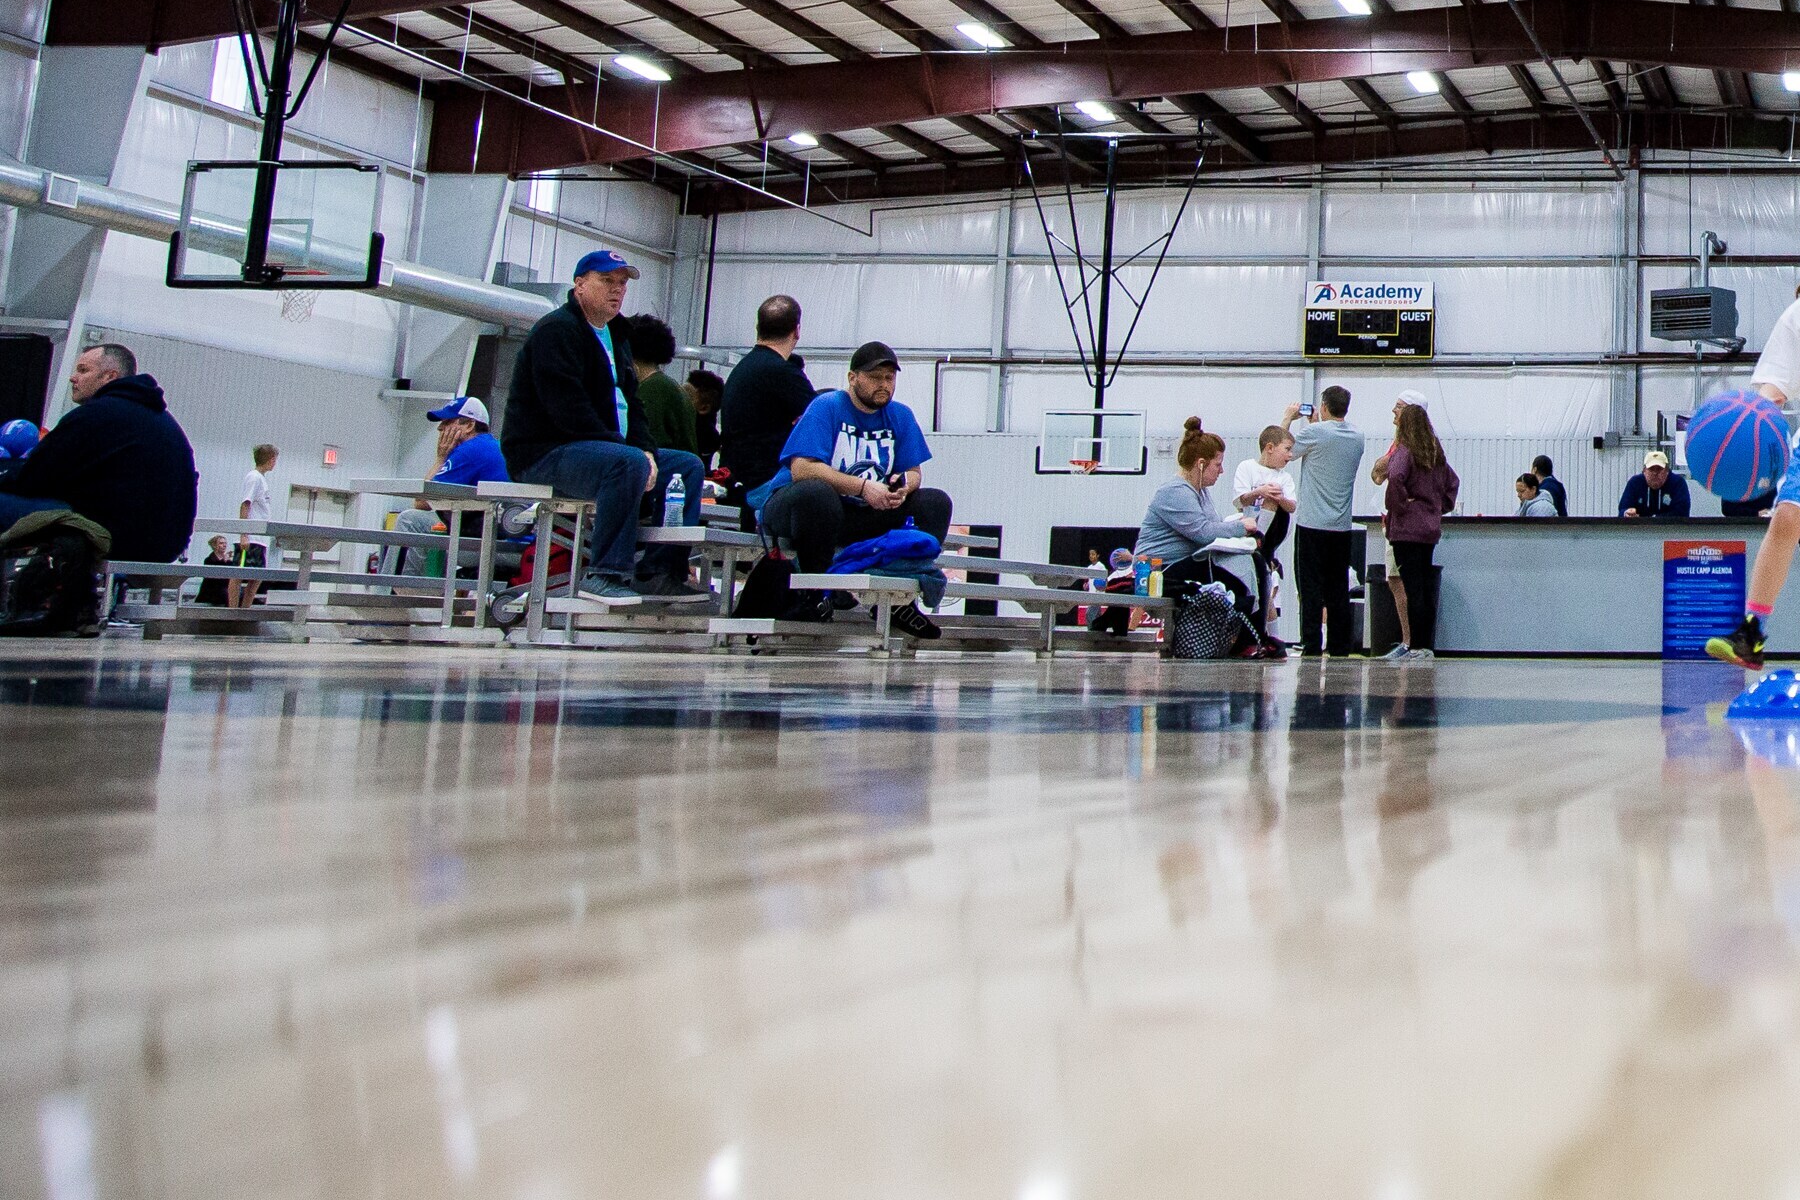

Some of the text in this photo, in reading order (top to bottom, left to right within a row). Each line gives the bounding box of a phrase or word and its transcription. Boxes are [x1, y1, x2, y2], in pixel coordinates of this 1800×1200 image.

[1340, 283, 1423, 303] Academy
[1307, 311, 1336, 321] HOME
[1400, 311, 1431, 322] GUEST
[1677, 567, 1733, 575] HUSTLE CAMP AGENDA
